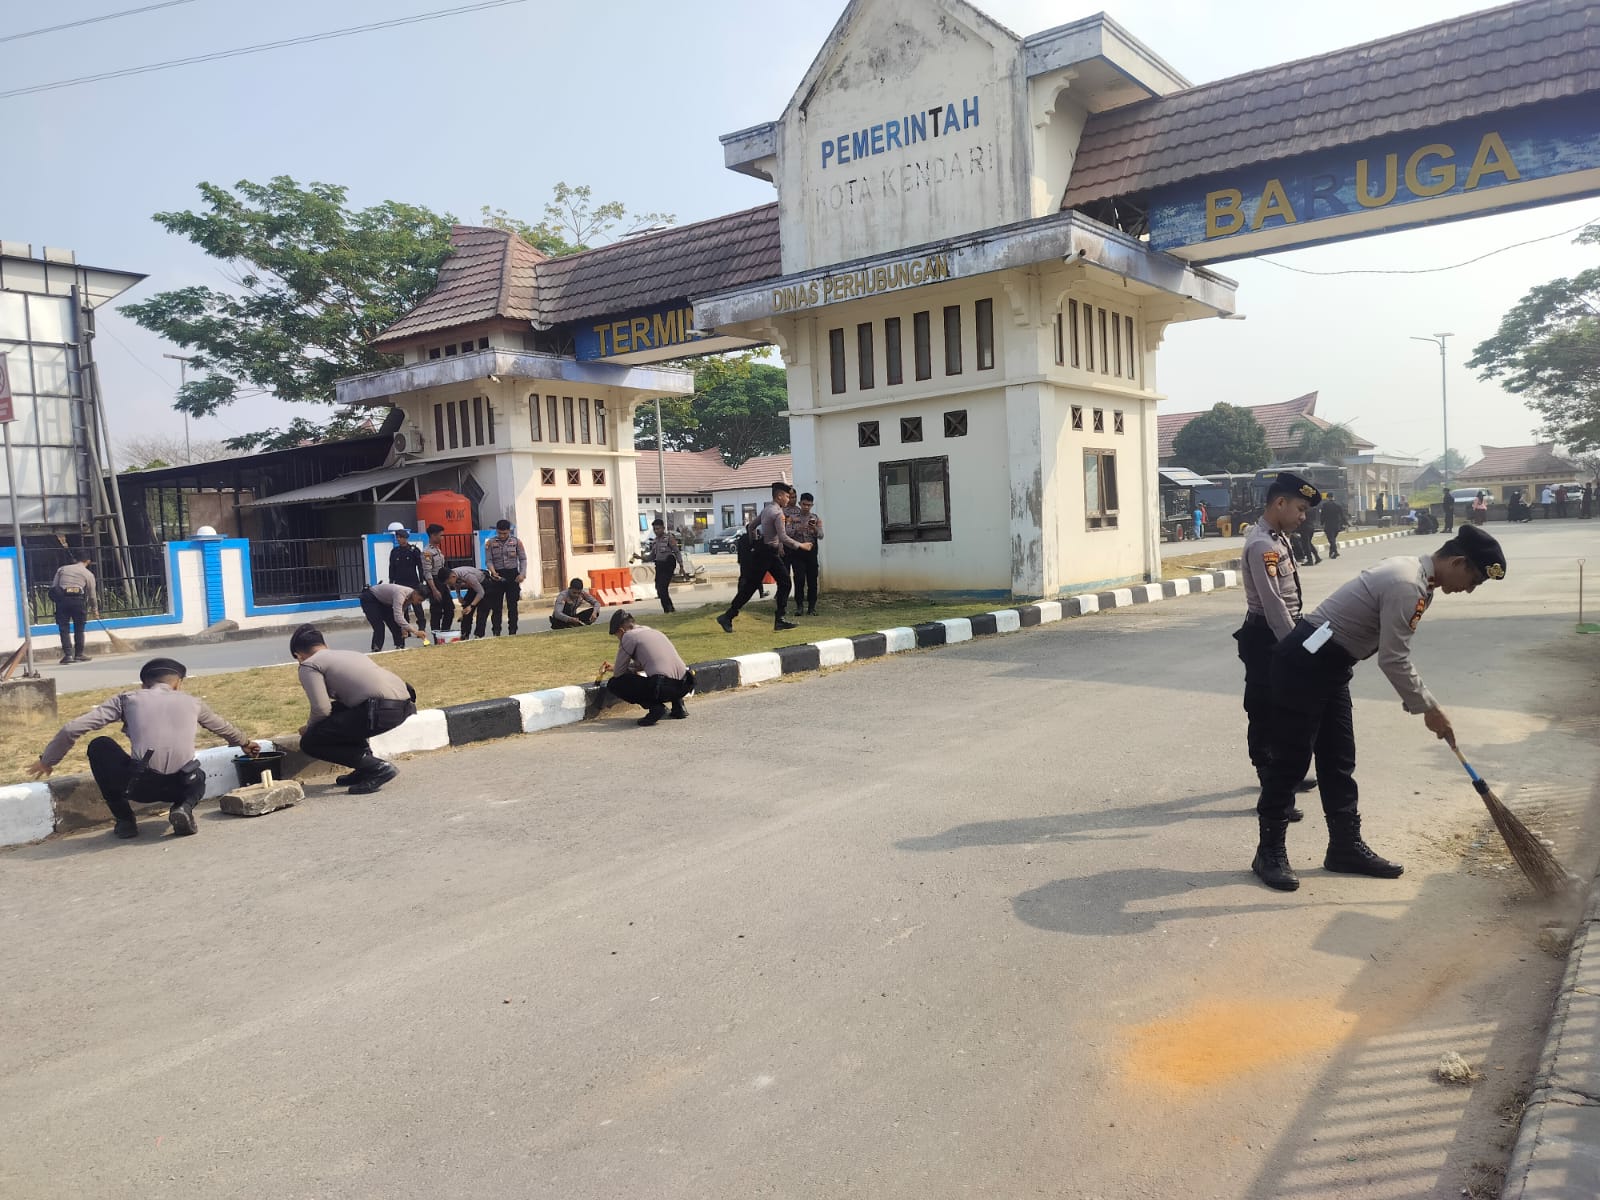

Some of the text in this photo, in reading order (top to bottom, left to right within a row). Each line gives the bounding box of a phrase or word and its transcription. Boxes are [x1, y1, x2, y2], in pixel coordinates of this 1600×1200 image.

[821, 95, 980, 169] PEMERINTAH
[1205, 131, 1521, 238] BARUGA
[772, 254, 950, 312] DINAS PERHUBUNGAN
